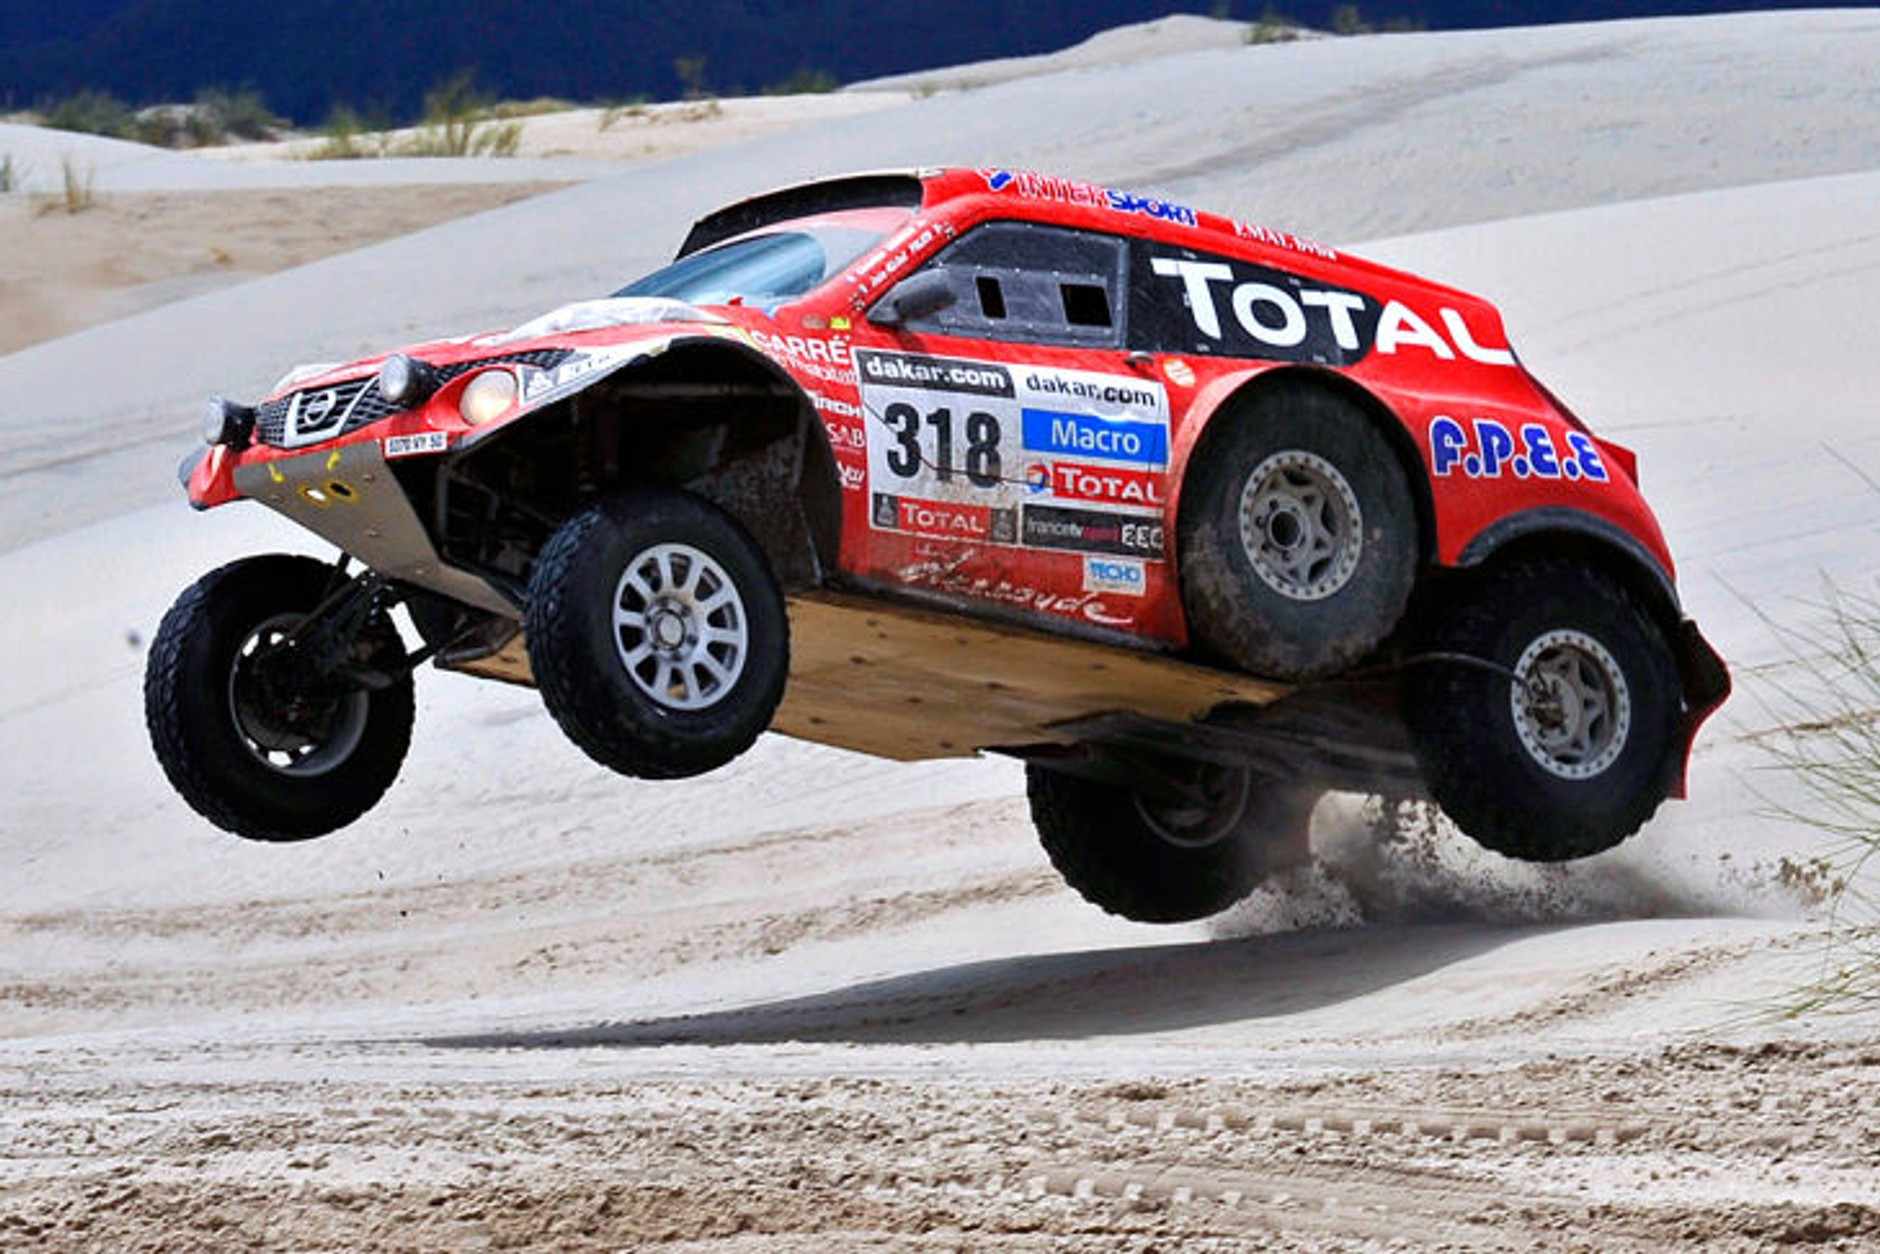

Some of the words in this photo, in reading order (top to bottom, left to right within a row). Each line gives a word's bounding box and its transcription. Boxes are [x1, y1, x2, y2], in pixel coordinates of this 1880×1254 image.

[1151, 257, 1518, 366] TOTAL
[865, 356, 1006, 388] dakar.com
[1025, 373, 1157, 407] dakar.com
[883, 402, 1001, 488] 318
[1051, 418, 1141, 453] Macro
[1057, 466, 1163, 501] TOTAL
[901, 502, 985, 534] TOTAL
